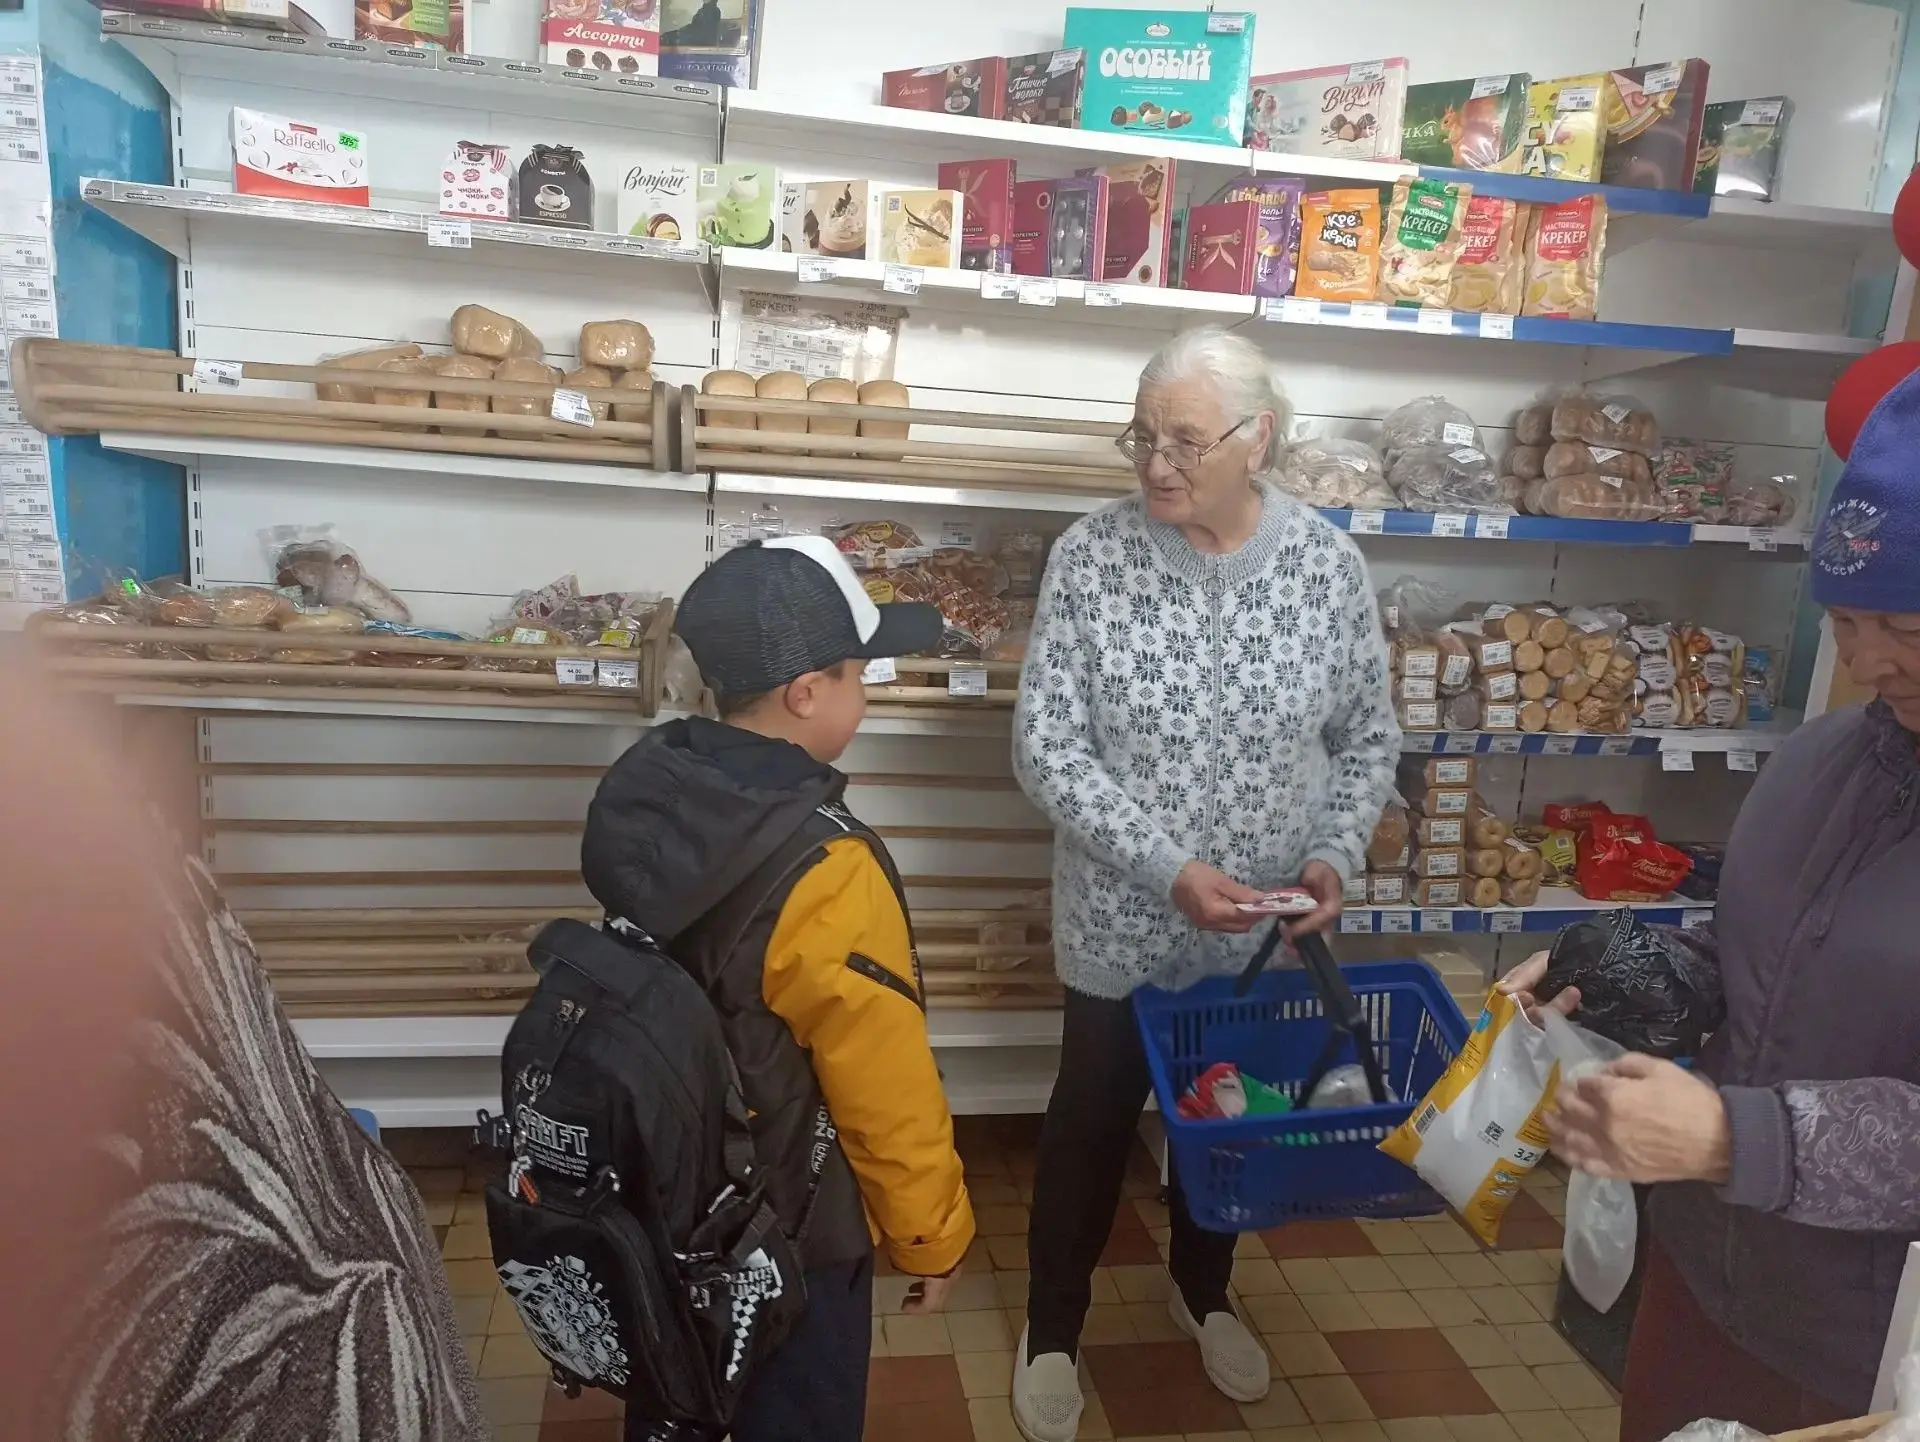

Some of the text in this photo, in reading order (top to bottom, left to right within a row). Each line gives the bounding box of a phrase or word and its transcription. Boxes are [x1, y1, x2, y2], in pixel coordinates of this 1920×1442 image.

[564, 23, 646, 49] Ассорти
[1099, 42, 1212, 81] ОСОБЫЙ
[274, 128, 336, 153] Raffaello
[623, 165, 690, 196] Bonjour
[539, 211, 567, 219] ESPRESSO
[1402, 215, 1447, 234] КРЕКЕР
[1541, 231, 1587, 244] КРЕКЕР
